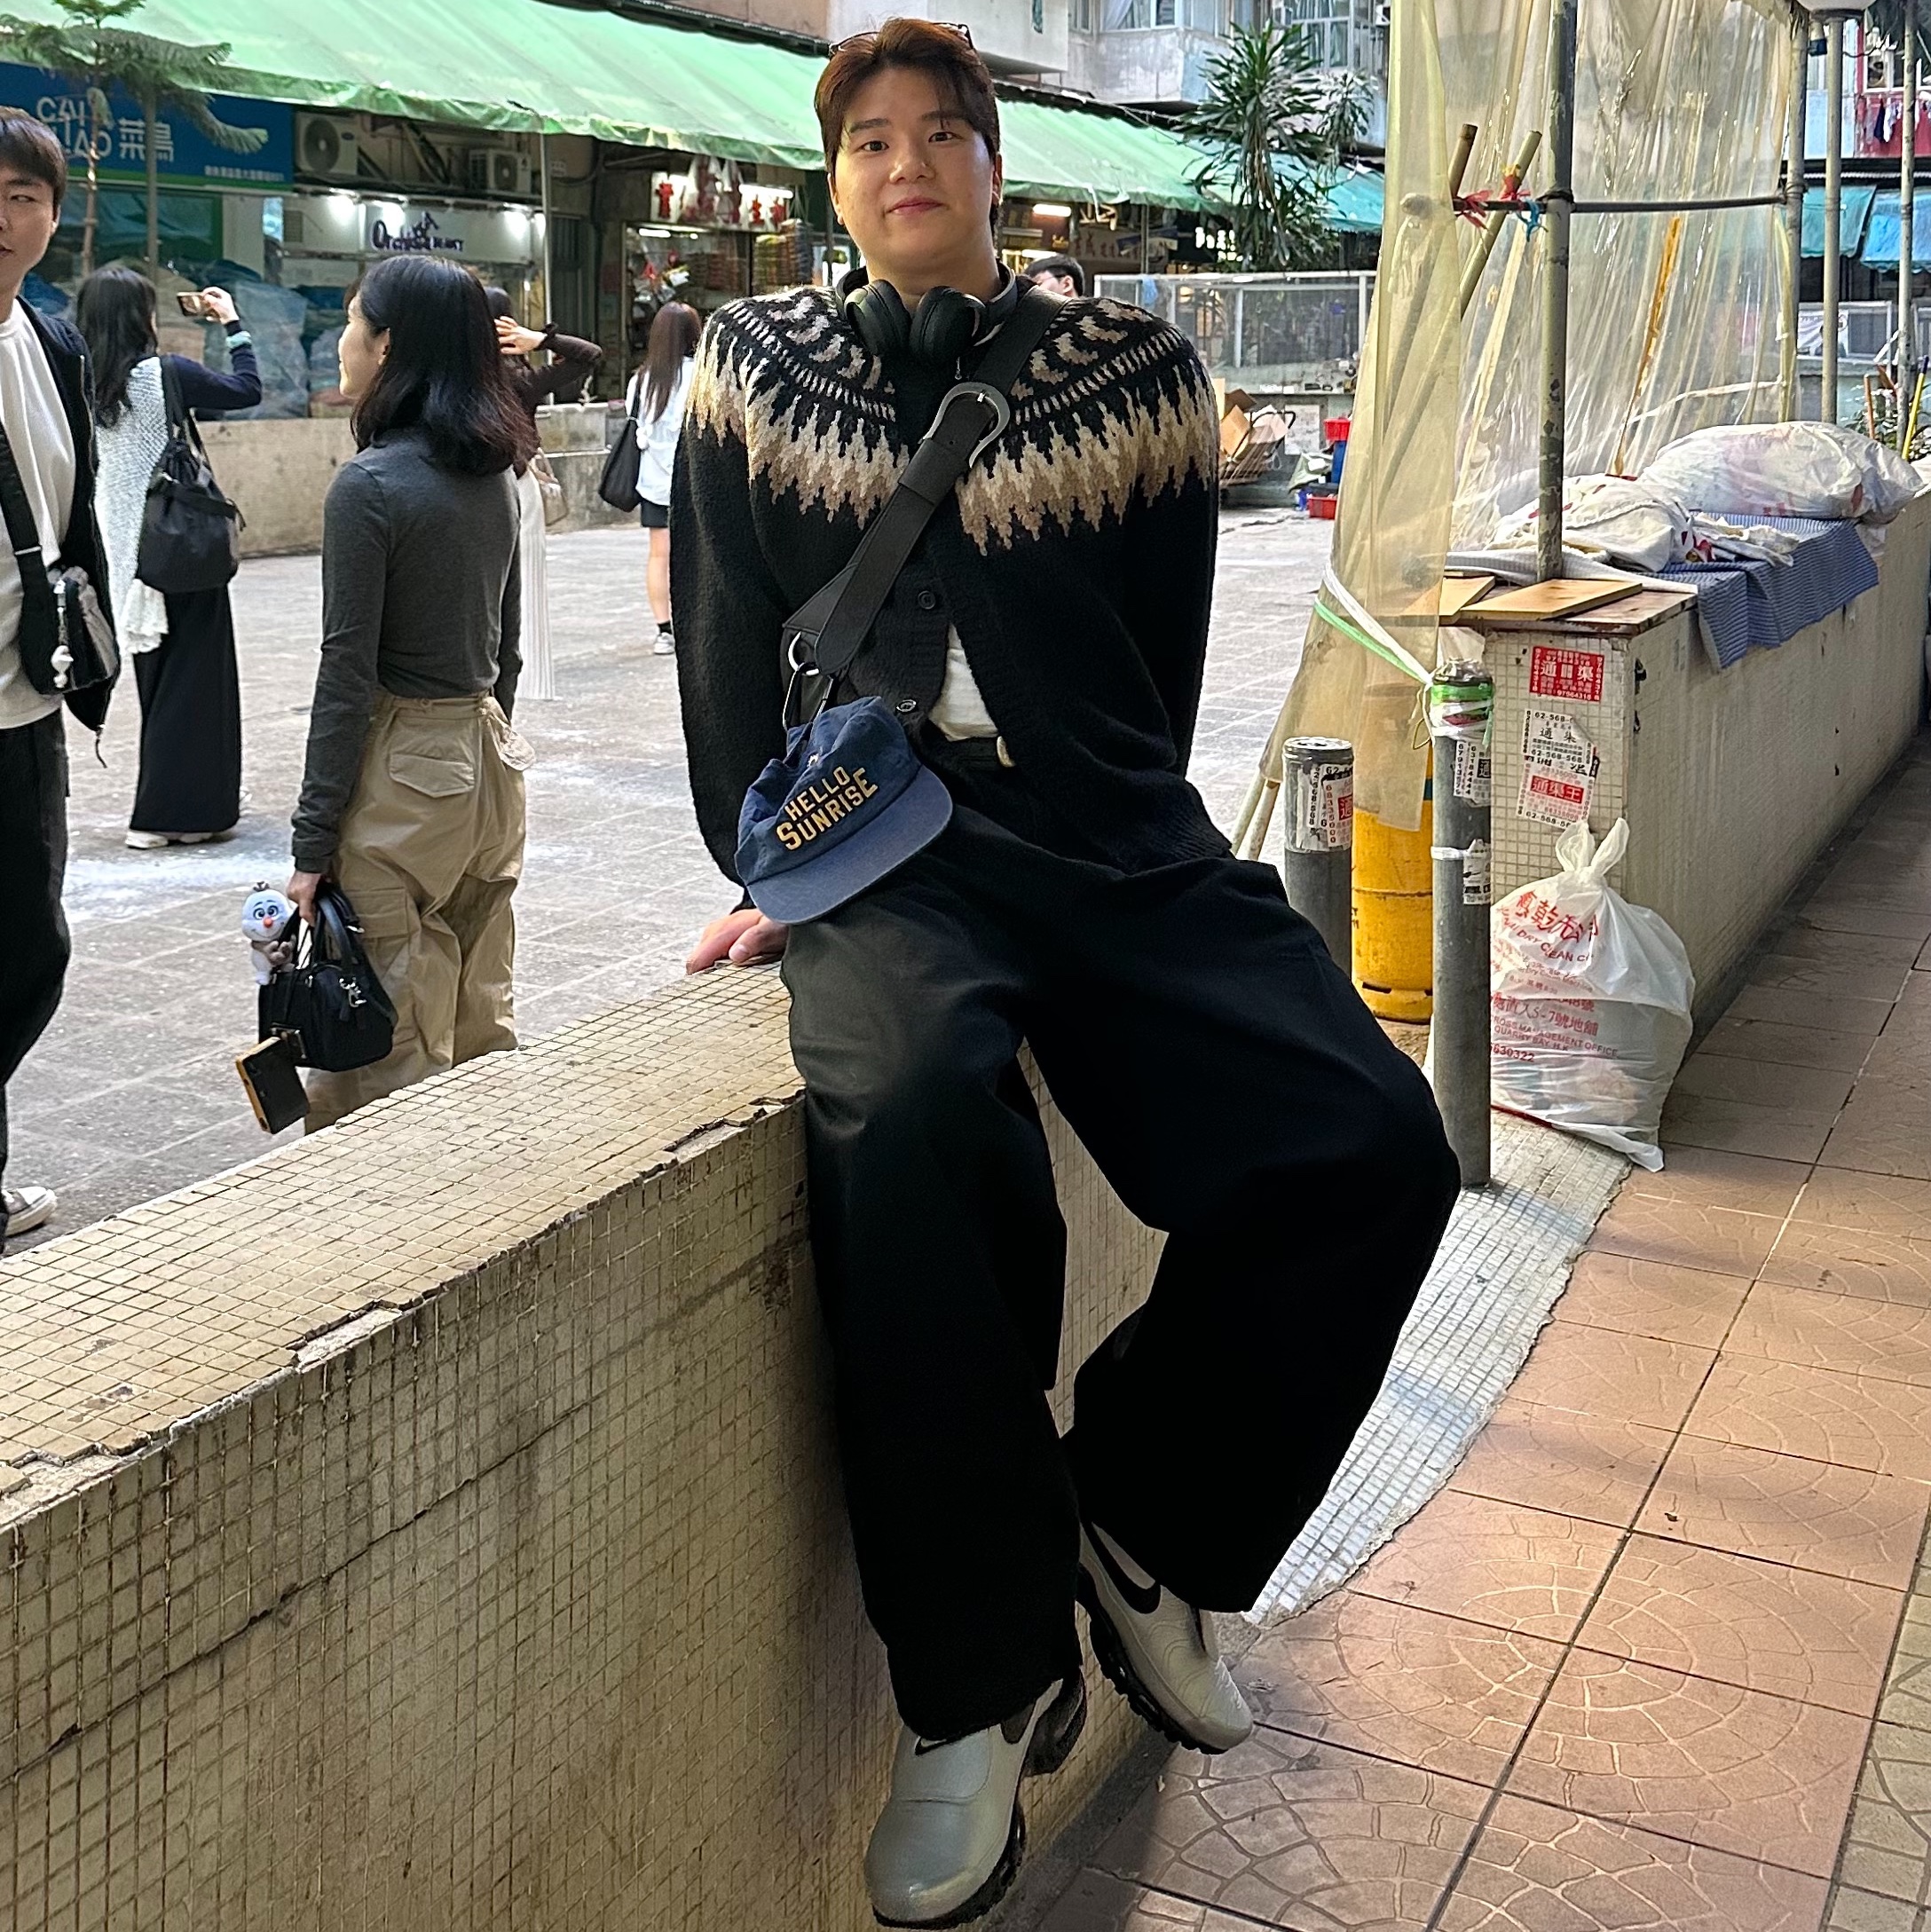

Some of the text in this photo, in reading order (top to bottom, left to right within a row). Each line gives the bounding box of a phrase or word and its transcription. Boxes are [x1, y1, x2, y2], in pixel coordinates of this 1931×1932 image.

[776, 768, 879, 851] SUNRISE
[784, 766, 850, 821] HELLO
[1540, 942, 1573, 962] CLEAN
[1491, 1042, 1535, 1062] 630322
